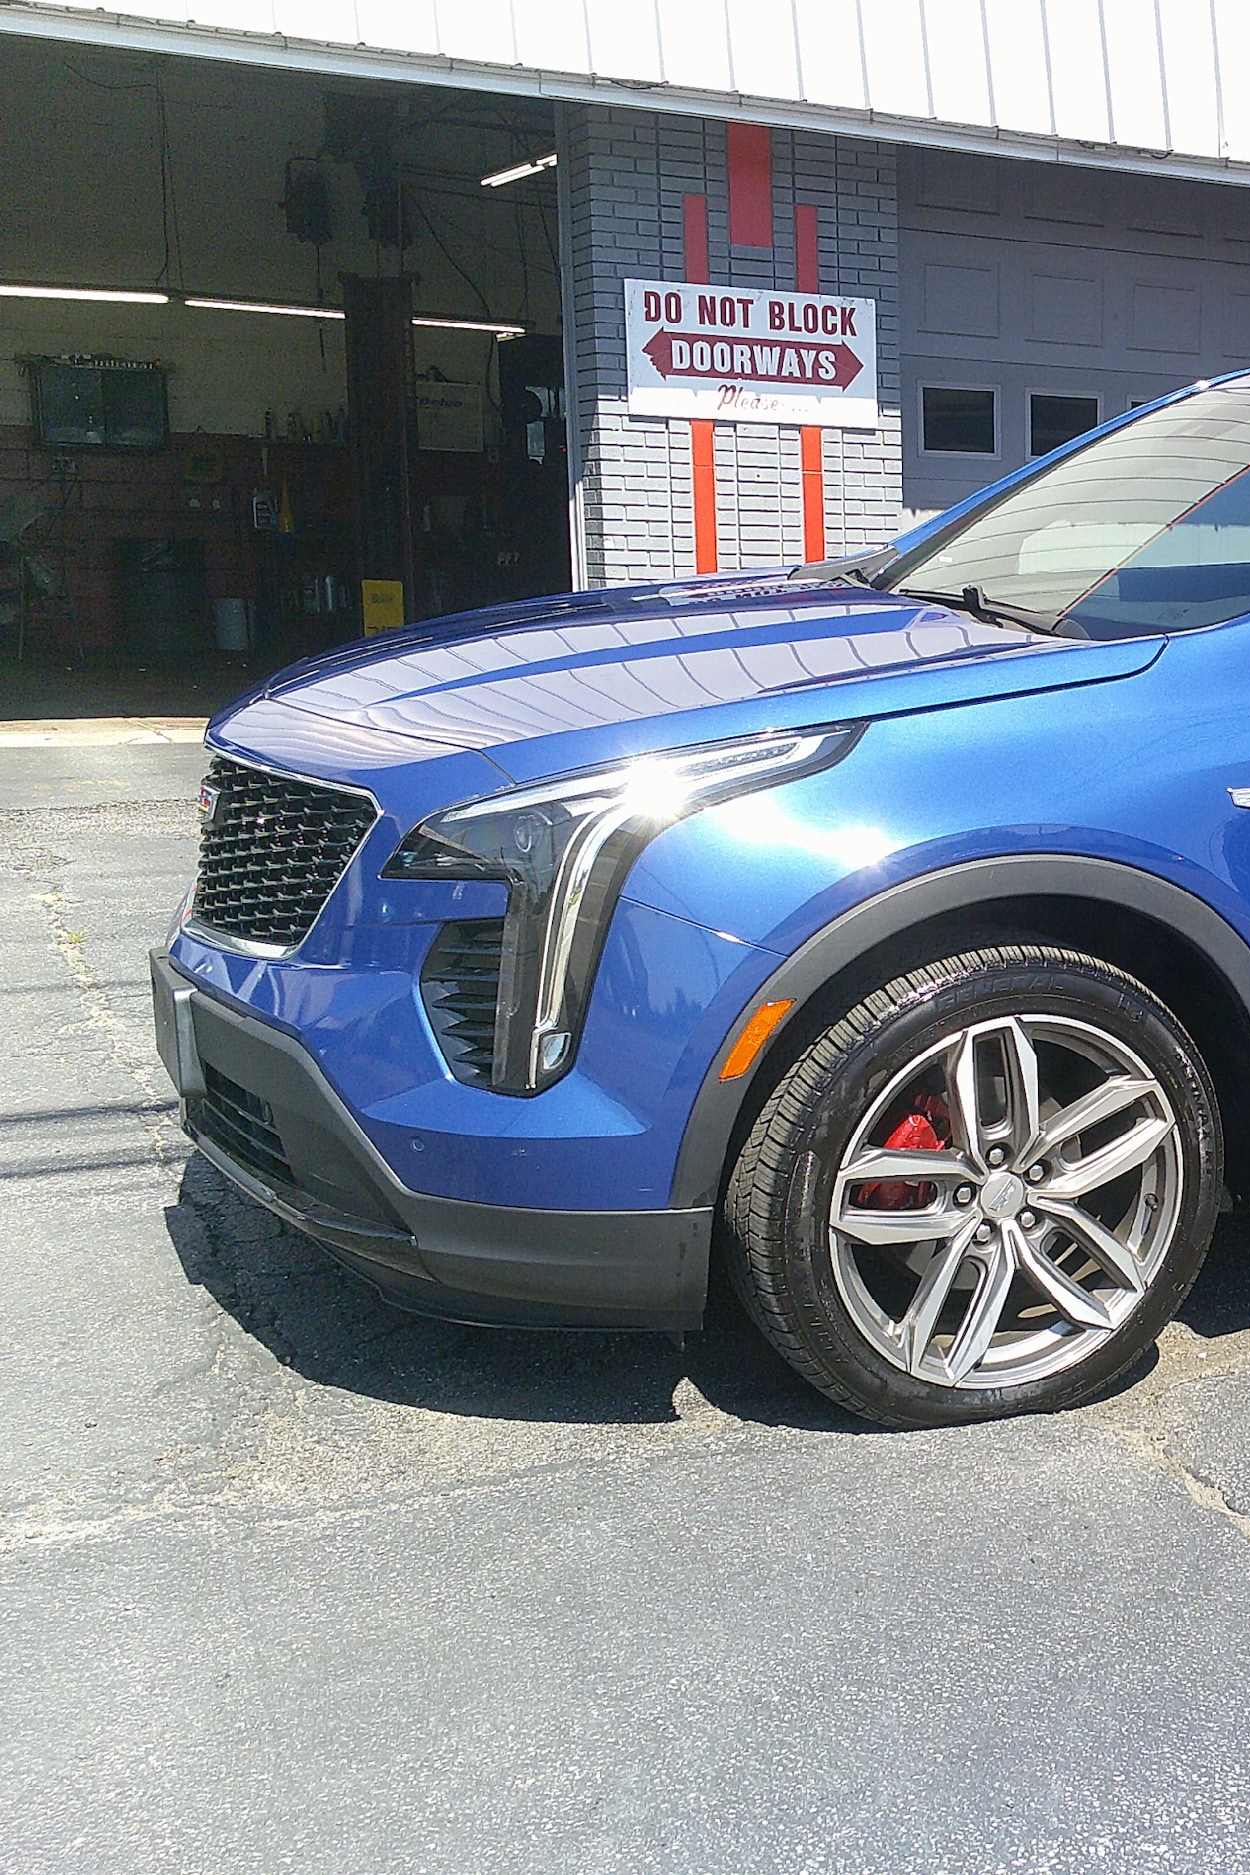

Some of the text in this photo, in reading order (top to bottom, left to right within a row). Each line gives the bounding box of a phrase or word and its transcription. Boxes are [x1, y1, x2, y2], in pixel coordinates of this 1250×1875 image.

[643, 290, 858, 337] DO NOT BLOCK
[671, 338, 837, 380] DOORWAYS
